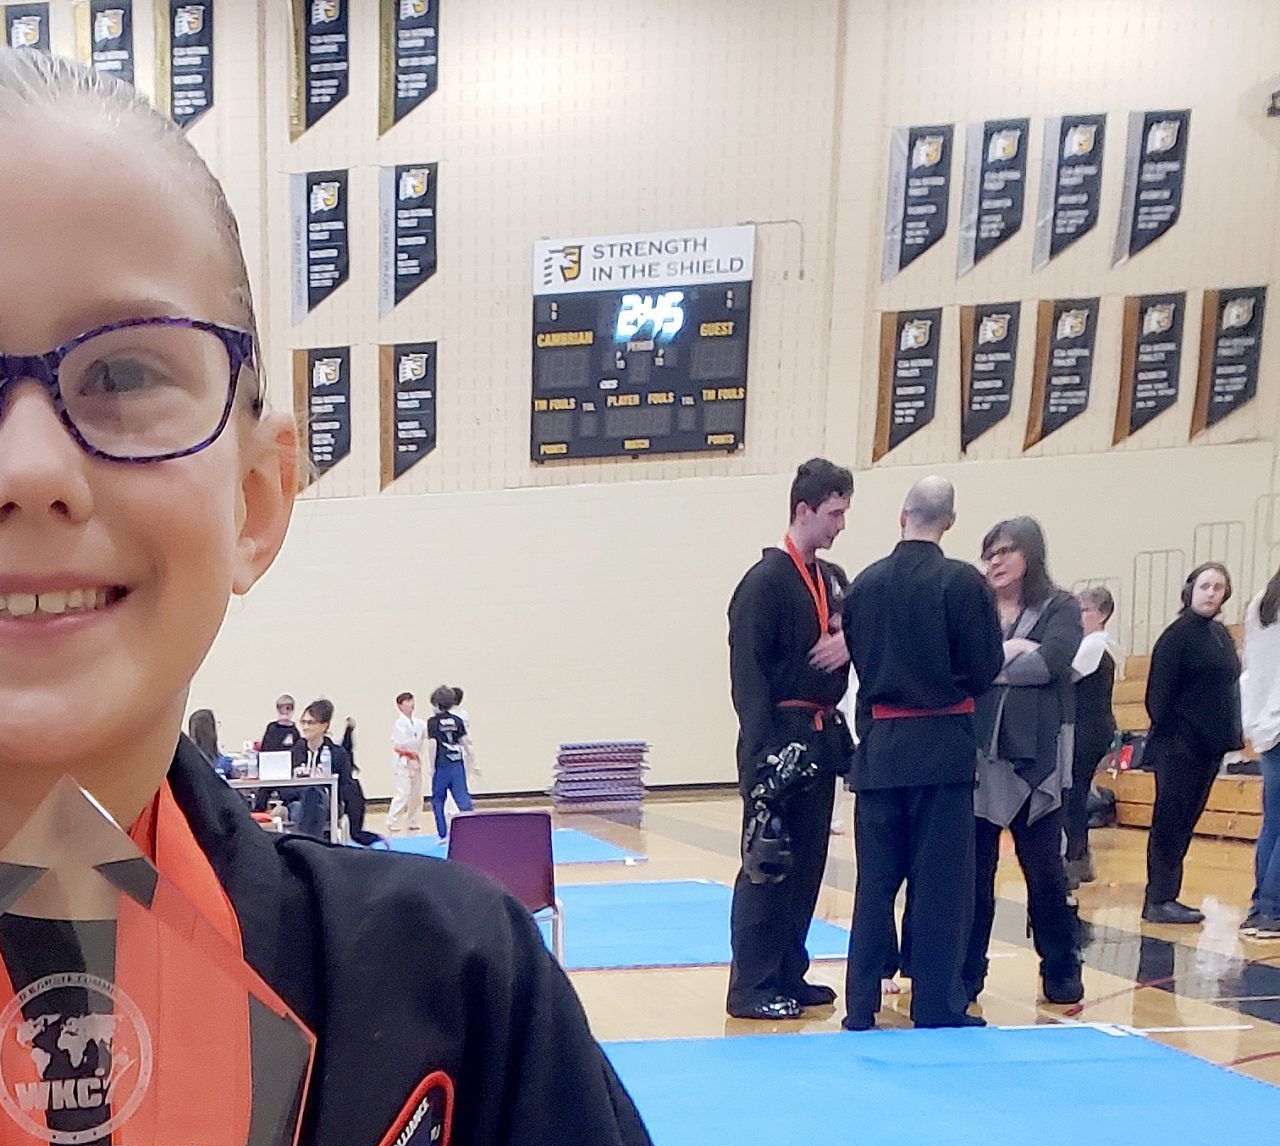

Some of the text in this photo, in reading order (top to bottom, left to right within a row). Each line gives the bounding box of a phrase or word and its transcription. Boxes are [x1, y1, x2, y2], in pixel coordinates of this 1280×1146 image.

[592, 237, 708, 260] STRENGTH
[592, 256, 745, 282] IN THE SHIELD
[15, 1076, 105, 1111] WKC
